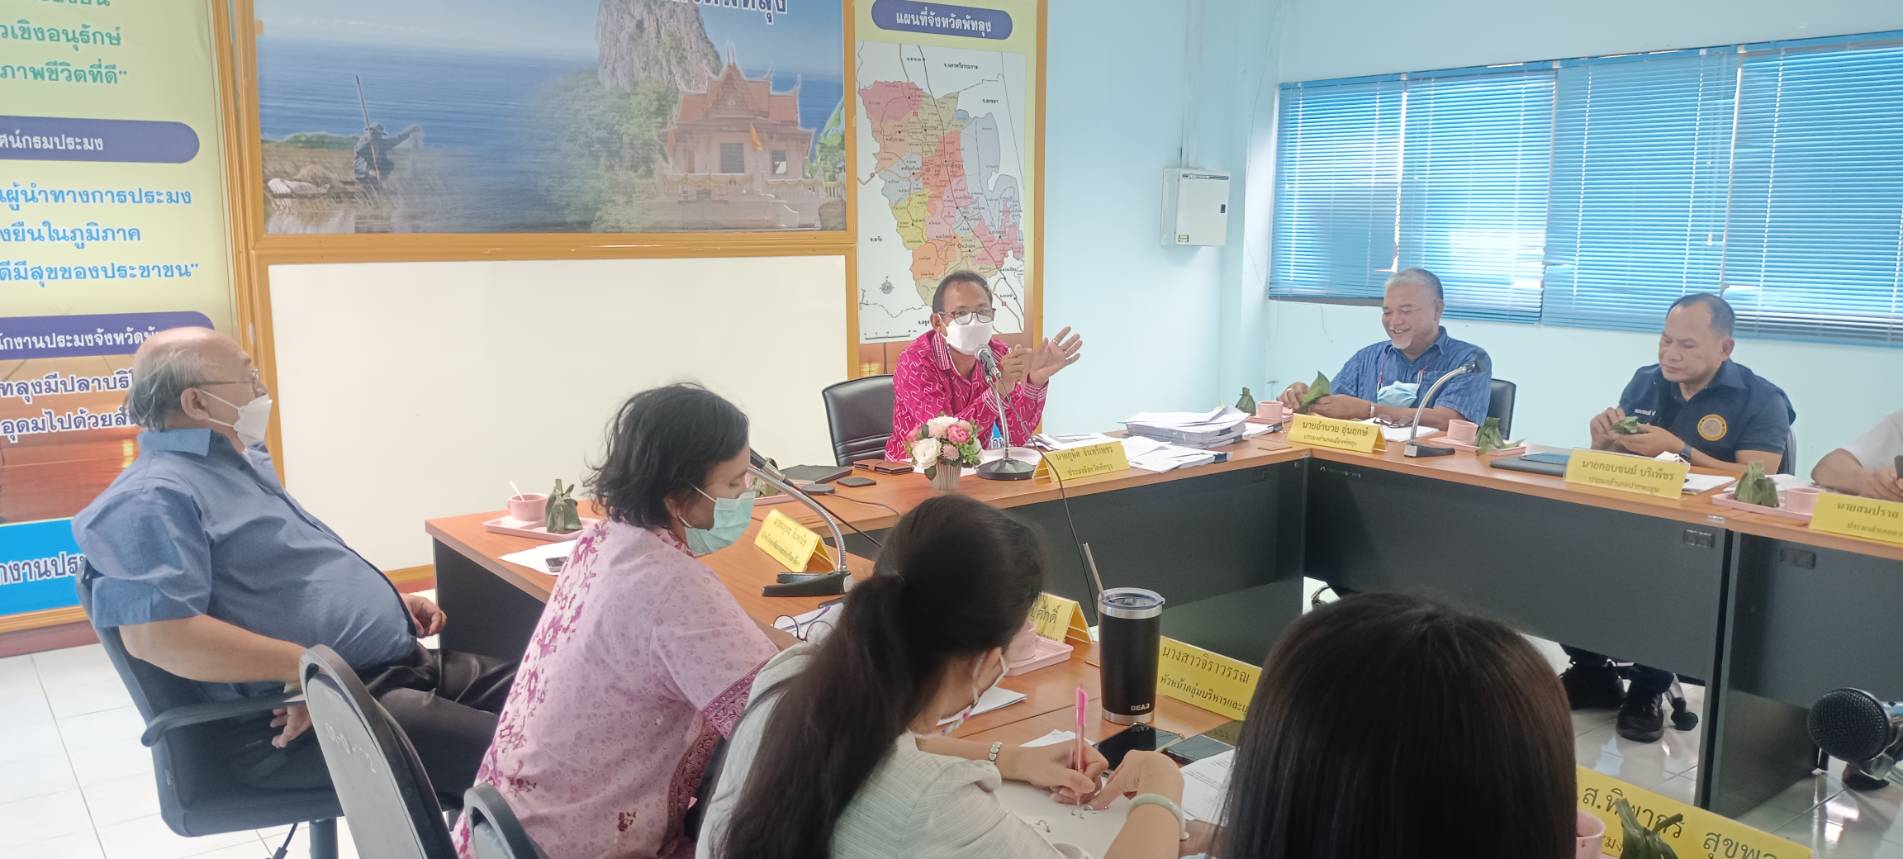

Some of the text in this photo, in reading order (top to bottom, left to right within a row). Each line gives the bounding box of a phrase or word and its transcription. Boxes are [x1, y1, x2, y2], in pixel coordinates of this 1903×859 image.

[896, 6, 992, 37] แผนที่จังหวัดพัทลุง
[1704, 832, 1778, 859] สุขพ
